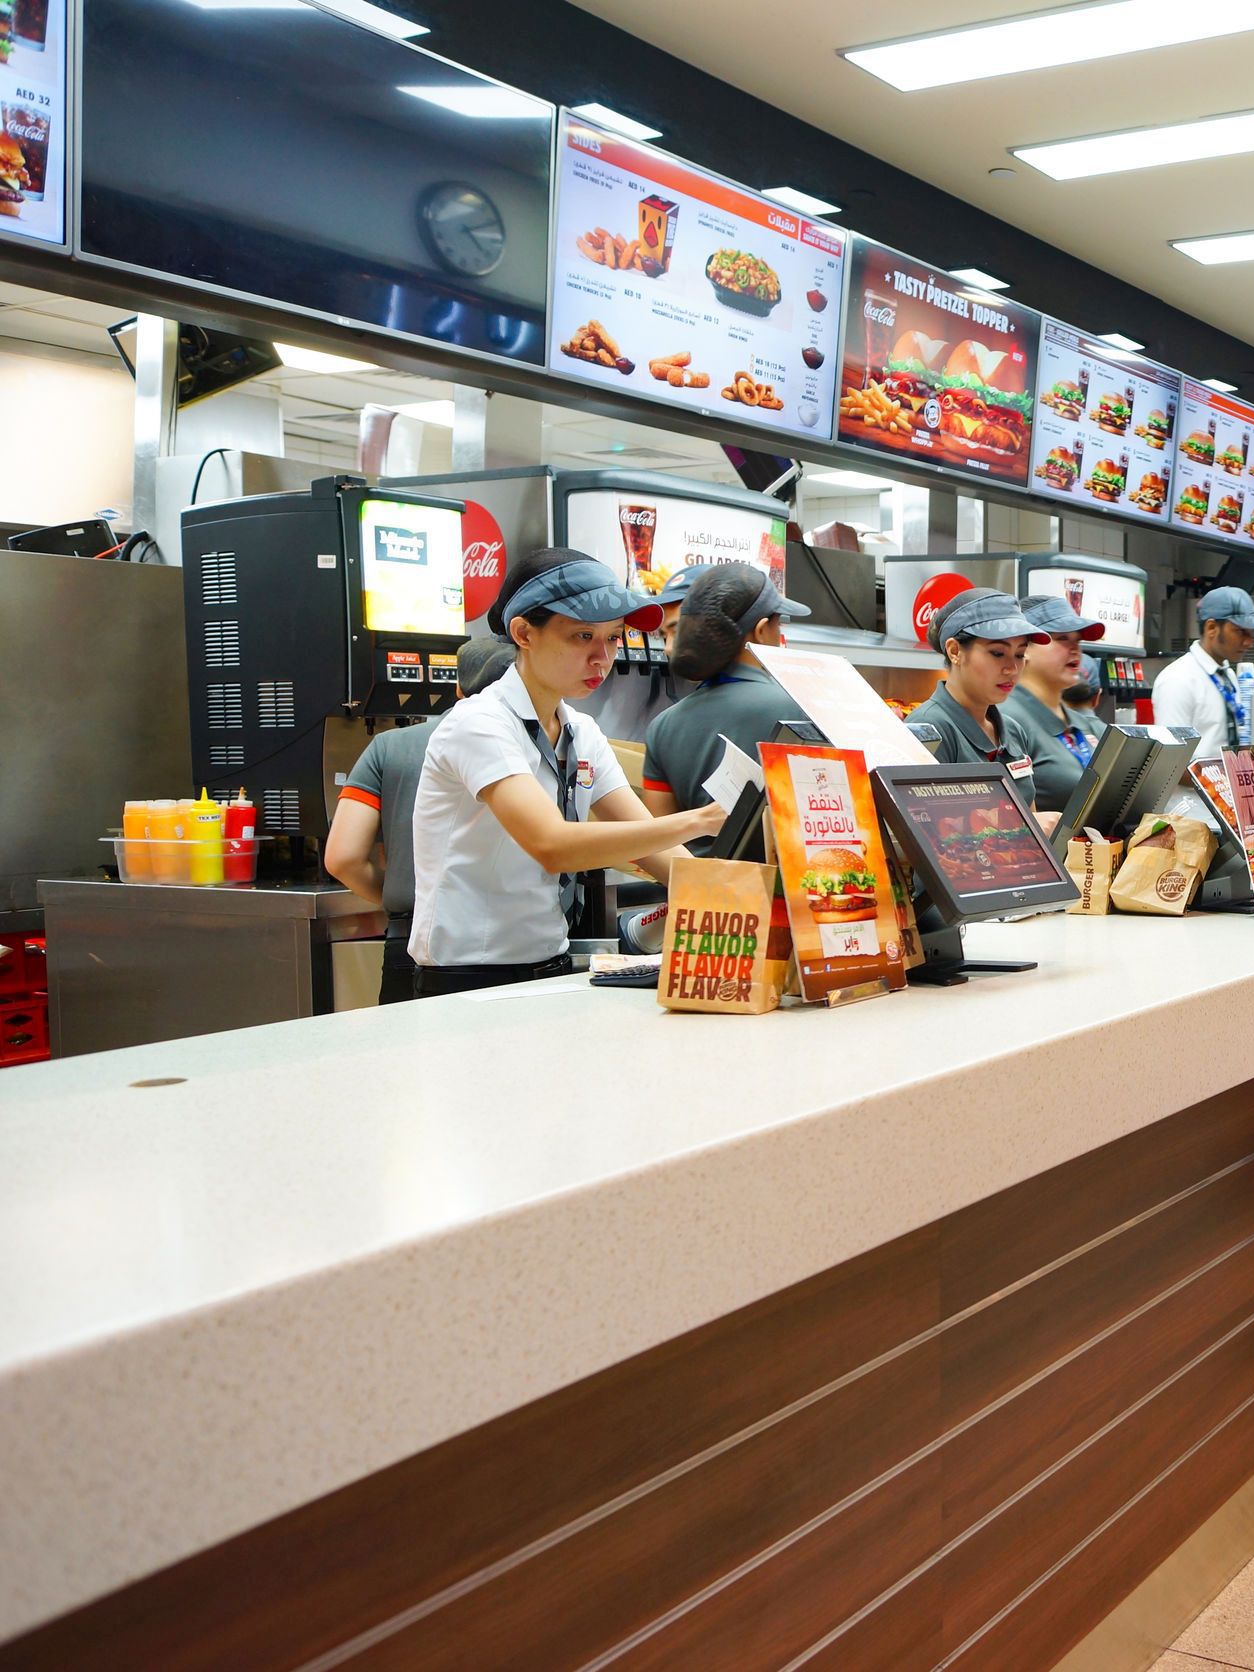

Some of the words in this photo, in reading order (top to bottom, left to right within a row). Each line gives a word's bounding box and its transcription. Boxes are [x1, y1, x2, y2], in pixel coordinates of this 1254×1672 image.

[16, 87, 35, 101] AED
[38, 94, 51, 107] 32
[767, 211, 796, 234] مقبلات
[893, 270, 926, 298] TASTY
[926, 283, 969, 319] PRETZEL
[972, 303, 1009, 334] TOPPER
[1098, 610, 1108, 620] GO
[1110, 611, 1129, 623] LARGE
[807, 793, 844, 811] احتفظ
[911, 785, 935, 798] TASTY
[962, 783, 991, 796] TOPPER
[803, 815, 855, 839] بالفاتورة
[1082, 867, 1094, 910] BURGER
[1158, 883, 1187, 895] KING
[1159, 875, 1188, 885] BURGER
[674, 908, 759, 938] FLAVOR
[673, 930, 758, 959] FLAVOR
[669, 950, 754, 981] FLAVOR
